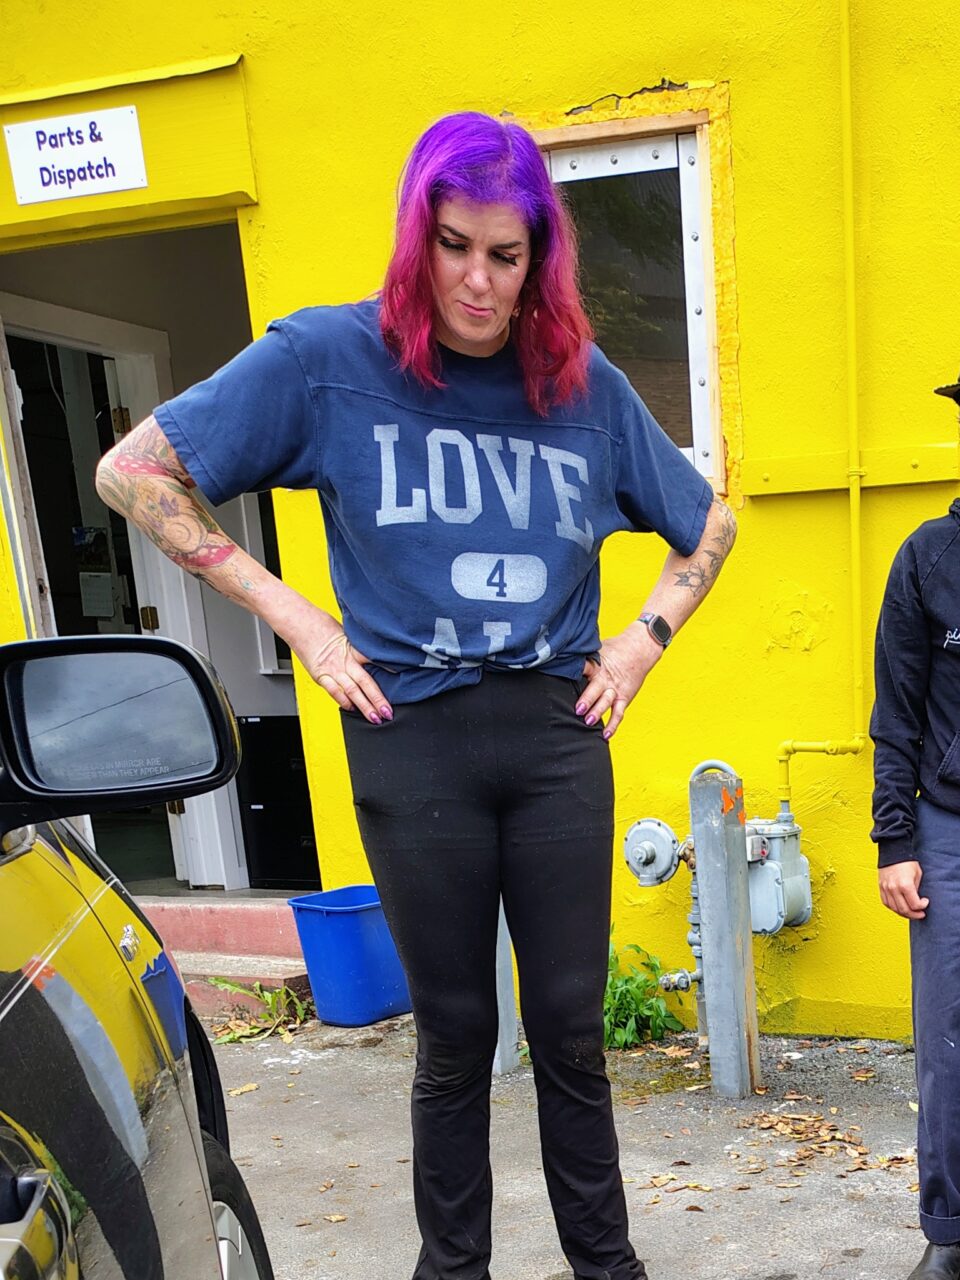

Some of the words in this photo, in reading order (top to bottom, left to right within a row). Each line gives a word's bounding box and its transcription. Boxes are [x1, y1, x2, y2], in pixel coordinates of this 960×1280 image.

[36, 127, 84, 151] Parts
[89, 121, 103, 143] &
[39, 157, 116, 189] Dispatch
[373, 424, 595, 554] LOVE
[486, 559, 507, 598] 4
